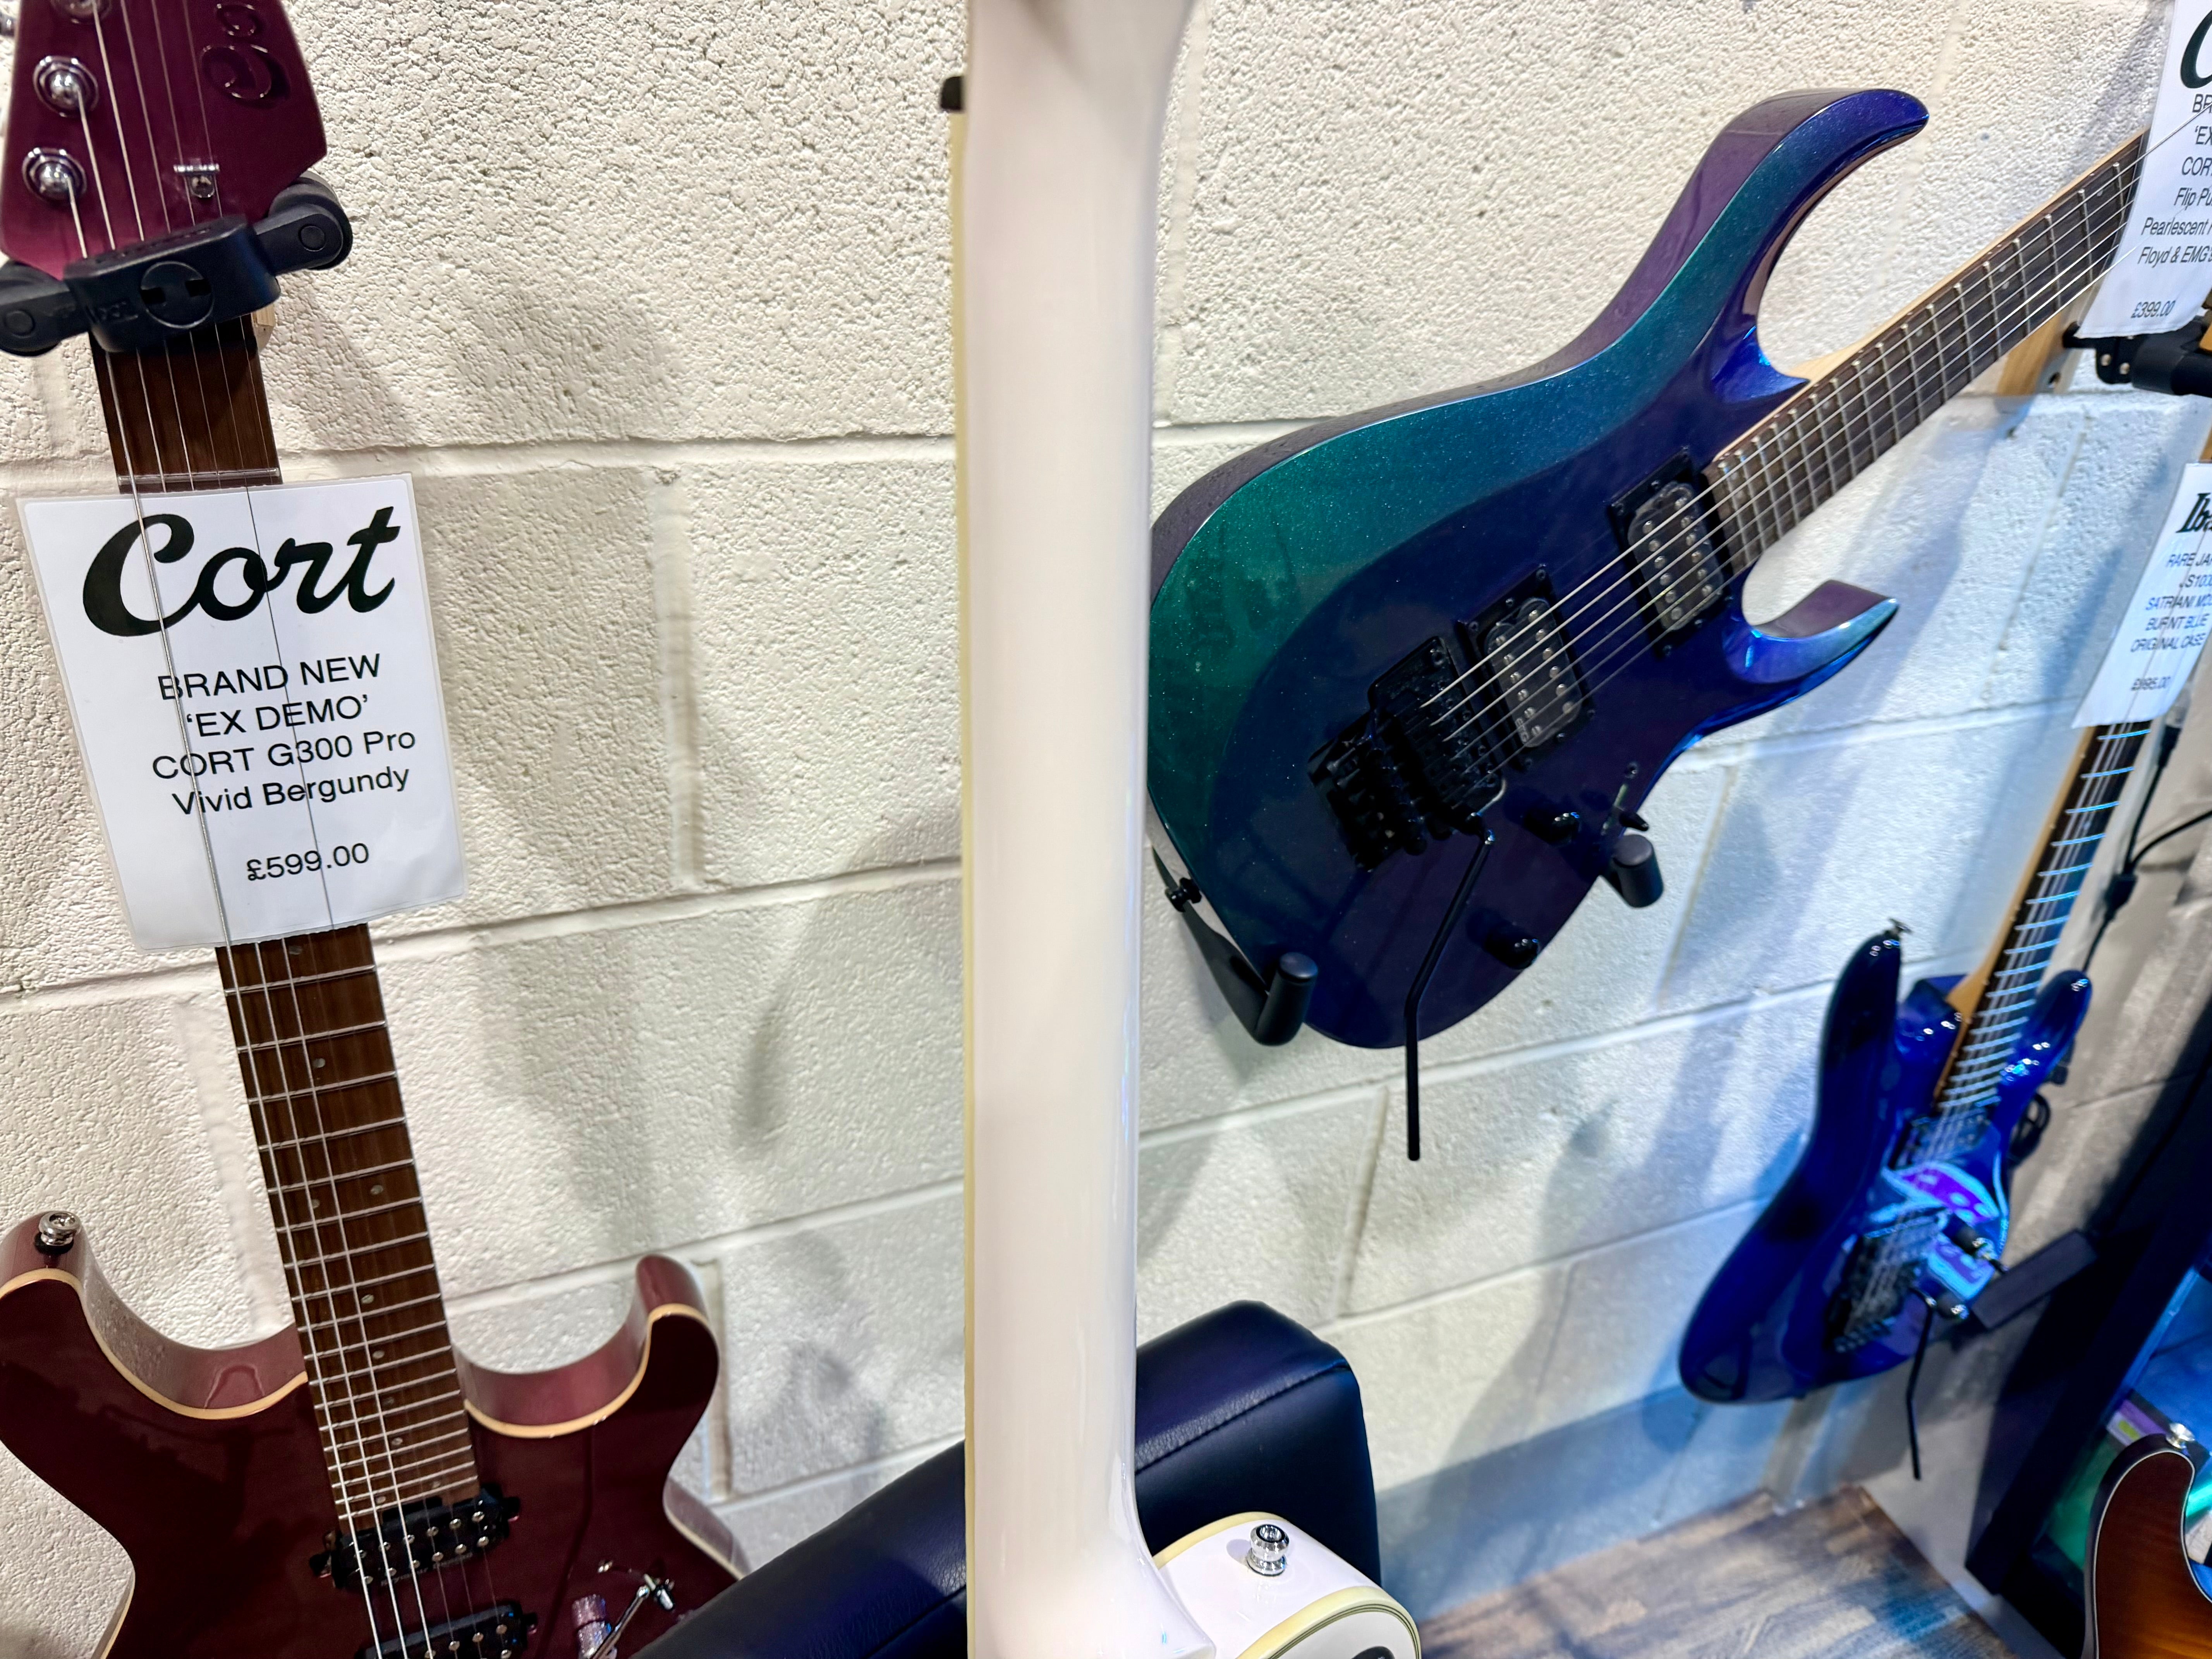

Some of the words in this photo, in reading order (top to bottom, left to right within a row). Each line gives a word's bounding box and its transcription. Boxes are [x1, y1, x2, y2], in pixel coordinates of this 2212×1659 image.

[2192, 94, 2212, 113] BR
[2182, 156, 2212, 176] COR
[2174, 187, 2196, 211] Flip
[2197, 187, 2212, 206] Pu
[2141, 217, 2209, 235] Pearlescent
[2137, 247, 2172, 268] Floyd
[2170, 246, 2181, 263] &
[2131, 300, 2176, 318] £399.00
[82, 506, 401, 637] Cort
[2196, 553, 2212, 567] JA
[158, 665, 288, 700] BRAND
[300, 654, 380, 685] NEW
[187, 709, 247, 738] ‘EX
[256, 694, 369, 731] DEMO’
[153, 748, 256, 779] CORT
[268, 739, 353, 767] G300
[365, 731, 416, 754] Pro
[172, 787, 252, 815] Vivid
[263, 766, 410, 806] Bergundy
[247, 843, 369, 881] £599.00
